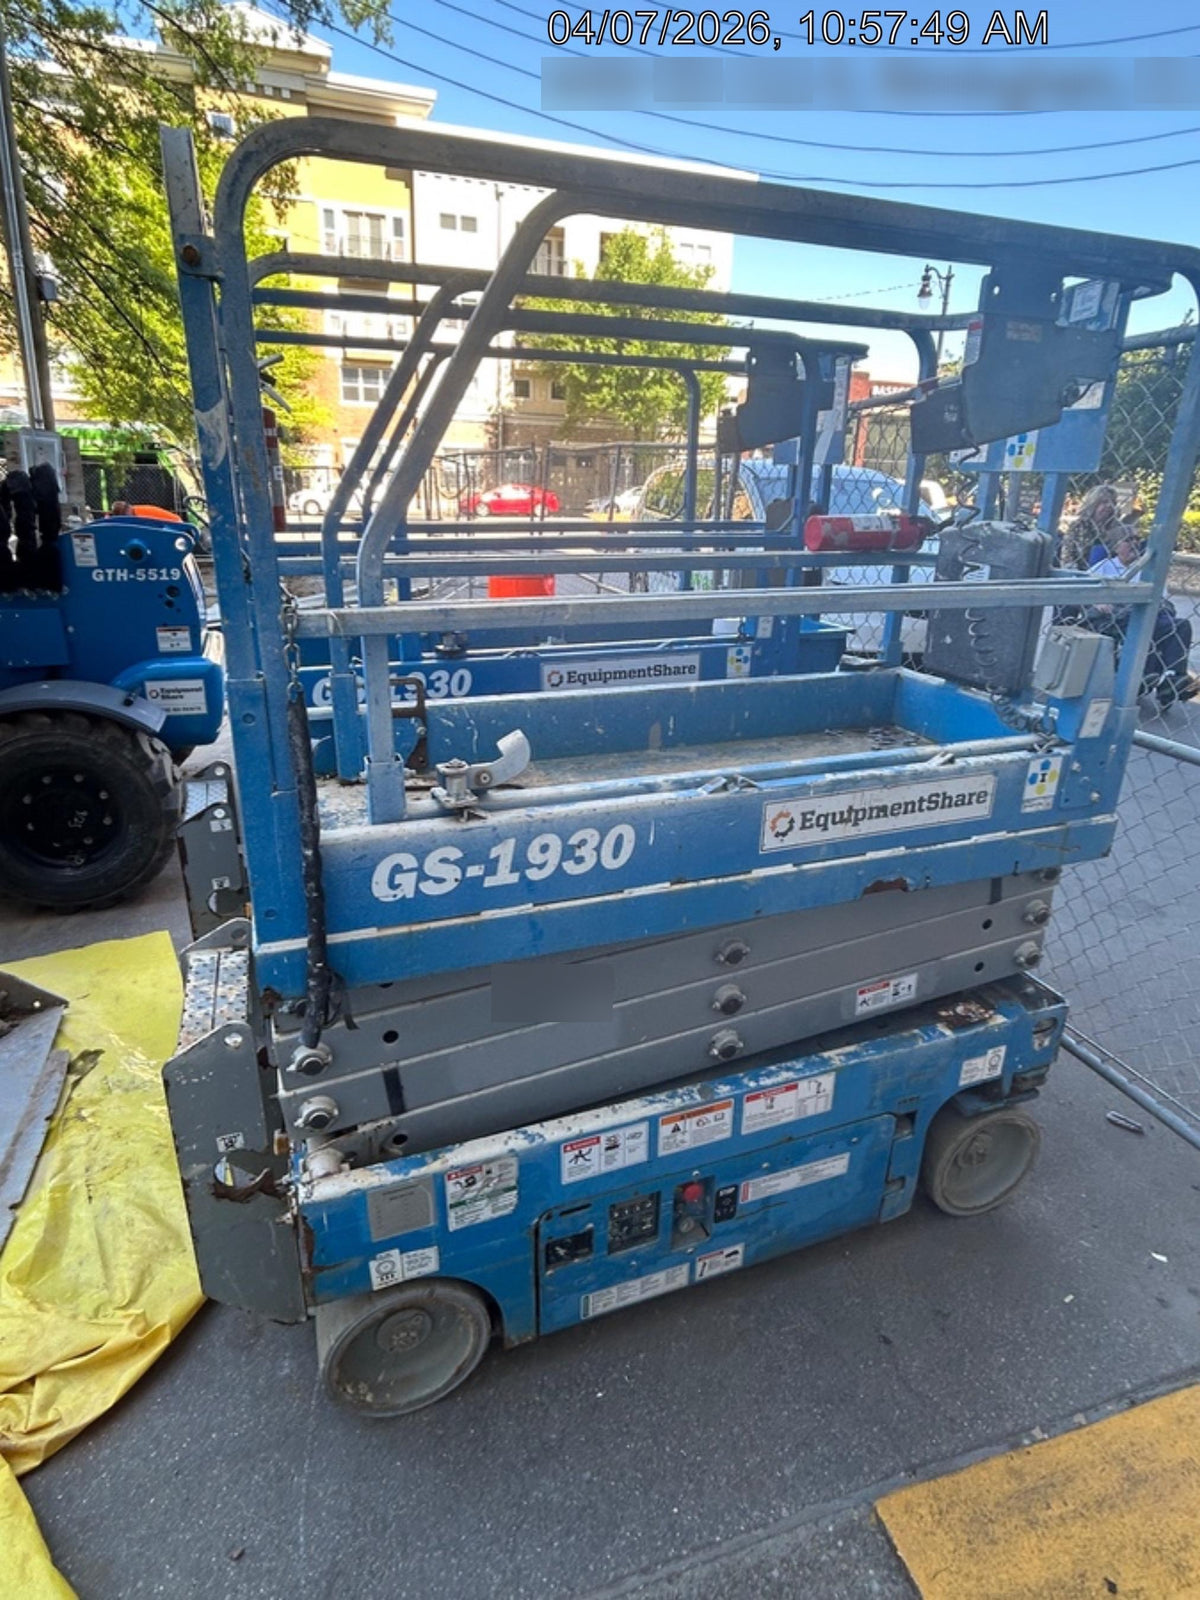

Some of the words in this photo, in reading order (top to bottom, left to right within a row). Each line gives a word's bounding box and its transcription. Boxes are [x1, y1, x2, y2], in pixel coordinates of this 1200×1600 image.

[91, 568, 182, 582] GTH-5519
[566, 664, 697, 685] EquipmentShare
[799, 790, 988, 832] EquipmentShare
[371, 824, 636, 902] GS-1930
